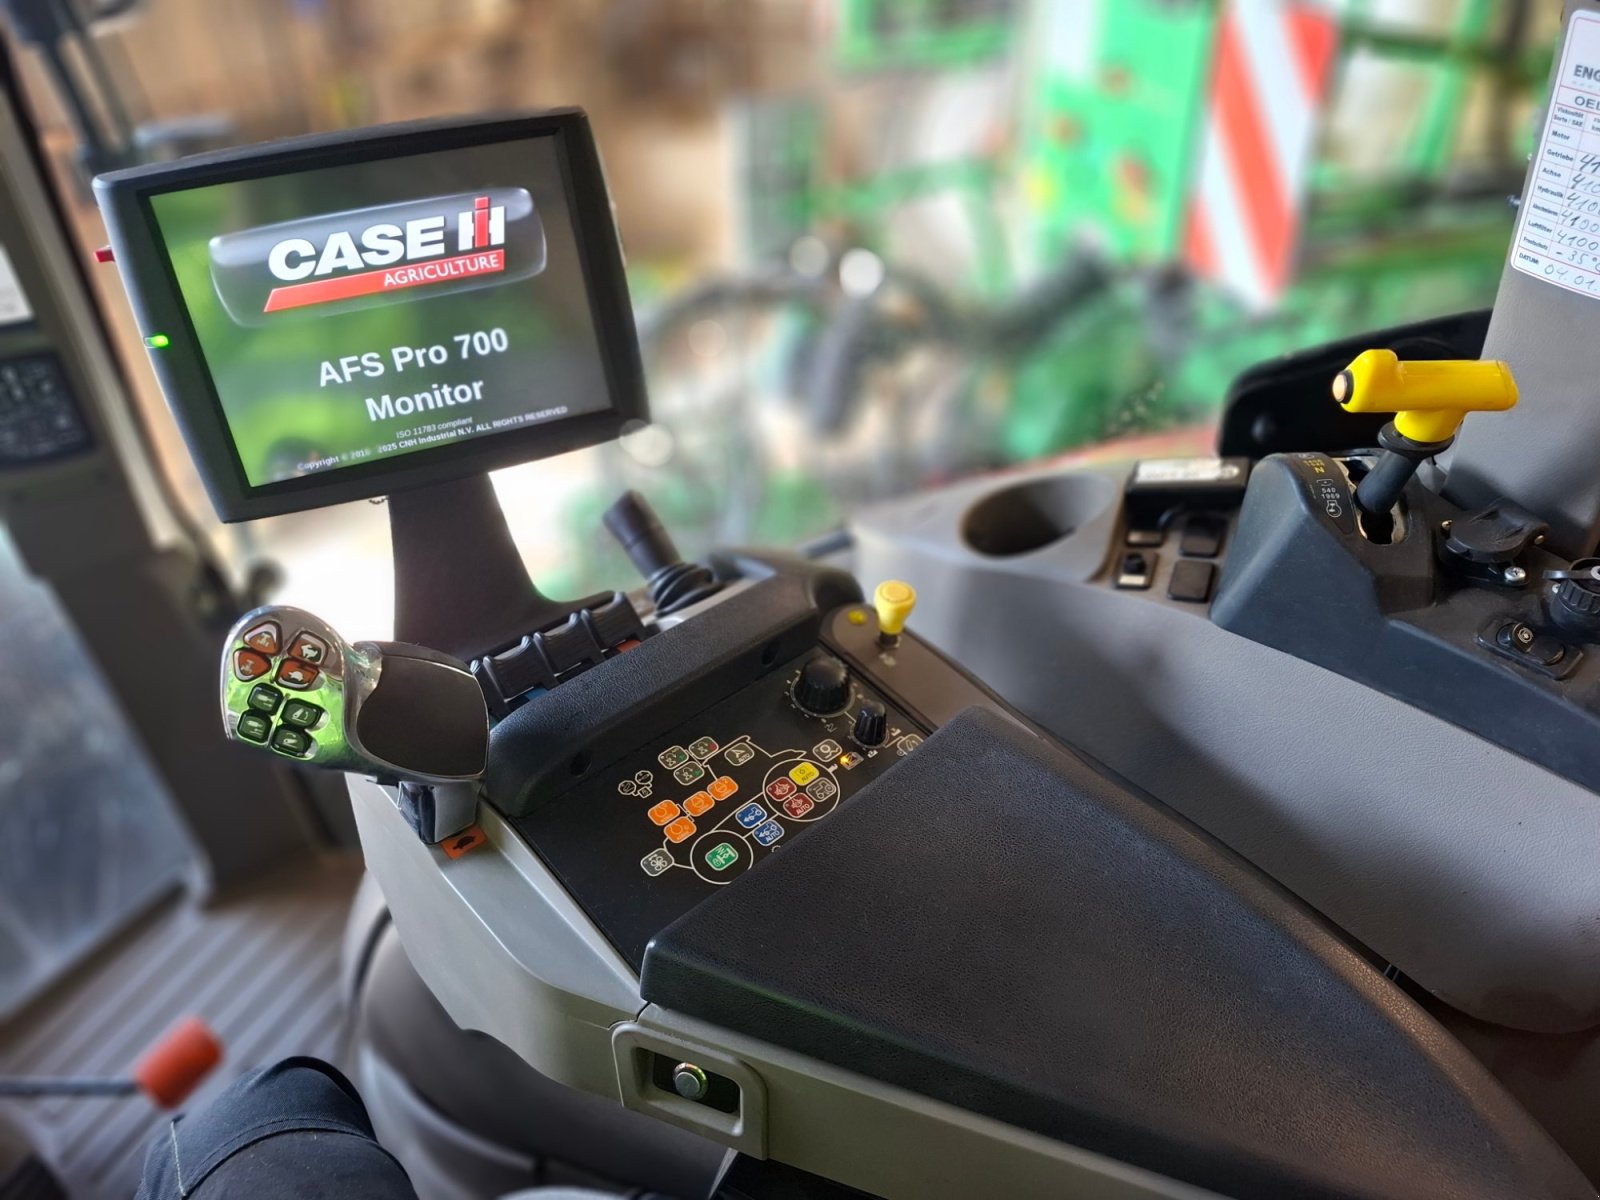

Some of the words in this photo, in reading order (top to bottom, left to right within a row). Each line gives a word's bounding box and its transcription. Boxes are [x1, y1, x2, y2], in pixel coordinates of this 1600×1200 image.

[1552, 130, 1570, 140] Motor
[1547, 148, 1574, 161] Getriebe
[1542, 167, 1561, 177] Achse
[1537, 185, 1564, 198] Hydraulik
[1528, 220, 1553, 233] Luftfilter
[268, 215, 446, 281] CASE
[1557, 230, 1599, 251] 4100
[383, 254, 500, 287] AGRICULTURE
[319, 352, 386, 387] AFS
[392, 344, 448, 373] Pro
[454, 327, 509, 360] 700
[365, 379, 485, 422] Monitor
[396, 429, 411, 439] ISO
[413, 424, 436, 436] 11783
[438, 416, 473, 432] compliant
[297, 455, 339, 471] Copyright
[398, 438, 418, 449] CNH
[418, 430, 457, 444] Industrial
[457, 426, 475, 436] N.V.
[476, 423, 492, 432] ALL
[492, 415, 524, 429] RIGHTS
[525, 405, 569, 421] RESERVED
[796, 803, 810, 815] AUTO
[766, 830, 780, 842] AUTO
